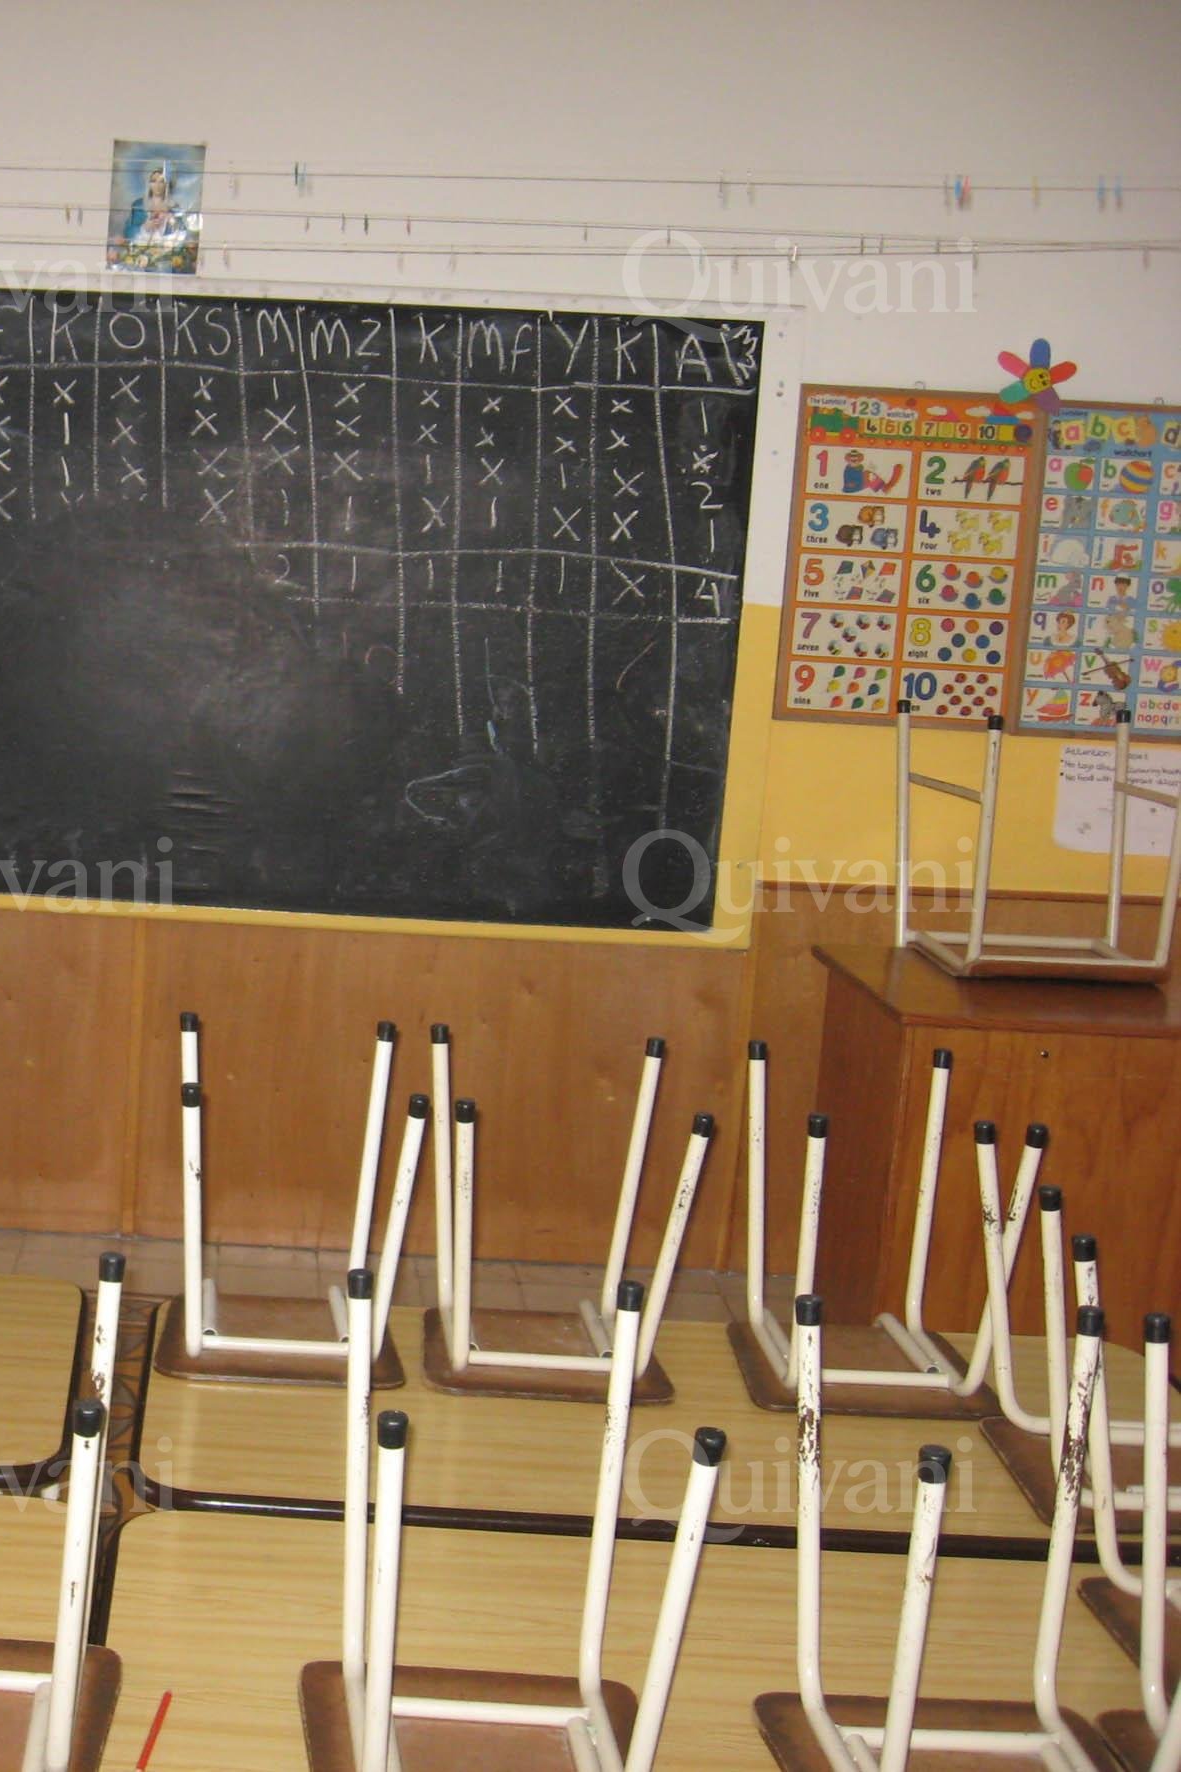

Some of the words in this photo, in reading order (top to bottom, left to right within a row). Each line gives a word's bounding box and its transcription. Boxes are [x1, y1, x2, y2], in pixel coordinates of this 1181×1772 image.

[51, 302, 84, 364] K
[109, 312, 145, 349] O
[419, 313, 446, 363] K
[615, 327, 642, 381] K
[675, 334, 713, 382] A
[925, 423, 934, 435] 7
[959, 424, 968, 437] 9
[980, 425, 995, 439] 10
[816, 450, 829, 477] 1
[925, 456, 946, 484] 2
[1048, 459, 1062, 472] a
[1104, 460, 1117, 478] b
[1165, 465, 1175, 478] c
[1045, 497, 1058, 511] e
[1101, 499, 1110, 517] f
[1159, 502, 1173, 521] g
[808, 503, 829, 531] 3
[920, 510, 940, 538] 4
[1042, 535, 1049, 552] i
[1097, 537, 1104, 561] j
[1156, 541, 1167, 560] k
[804, 558, 824, 586] 5
[916, 564, 936, 593] 6
[1037, 575, 1057, 588] m
[1091, 577, 1105, 591] n
[1152, 581, 1164, 594] o
[801, 612, 821, 639] 7
[1034, 613, 1047, 630] q
[1088, 616, 1097, 629] r
[1148, 620, 1158, 633] s
[909, 618, 931, 646] 8
[1029, 652, 1042, 666] u
[1085, 656, 1096, 668] v
[1143, 659, 1162, 671] w
[795, 665, 815, 692] 9
[903, 672, 937, 700] 10
[1027, 689, 1038, 706] y
[1080, 693, 1091, 706] z
